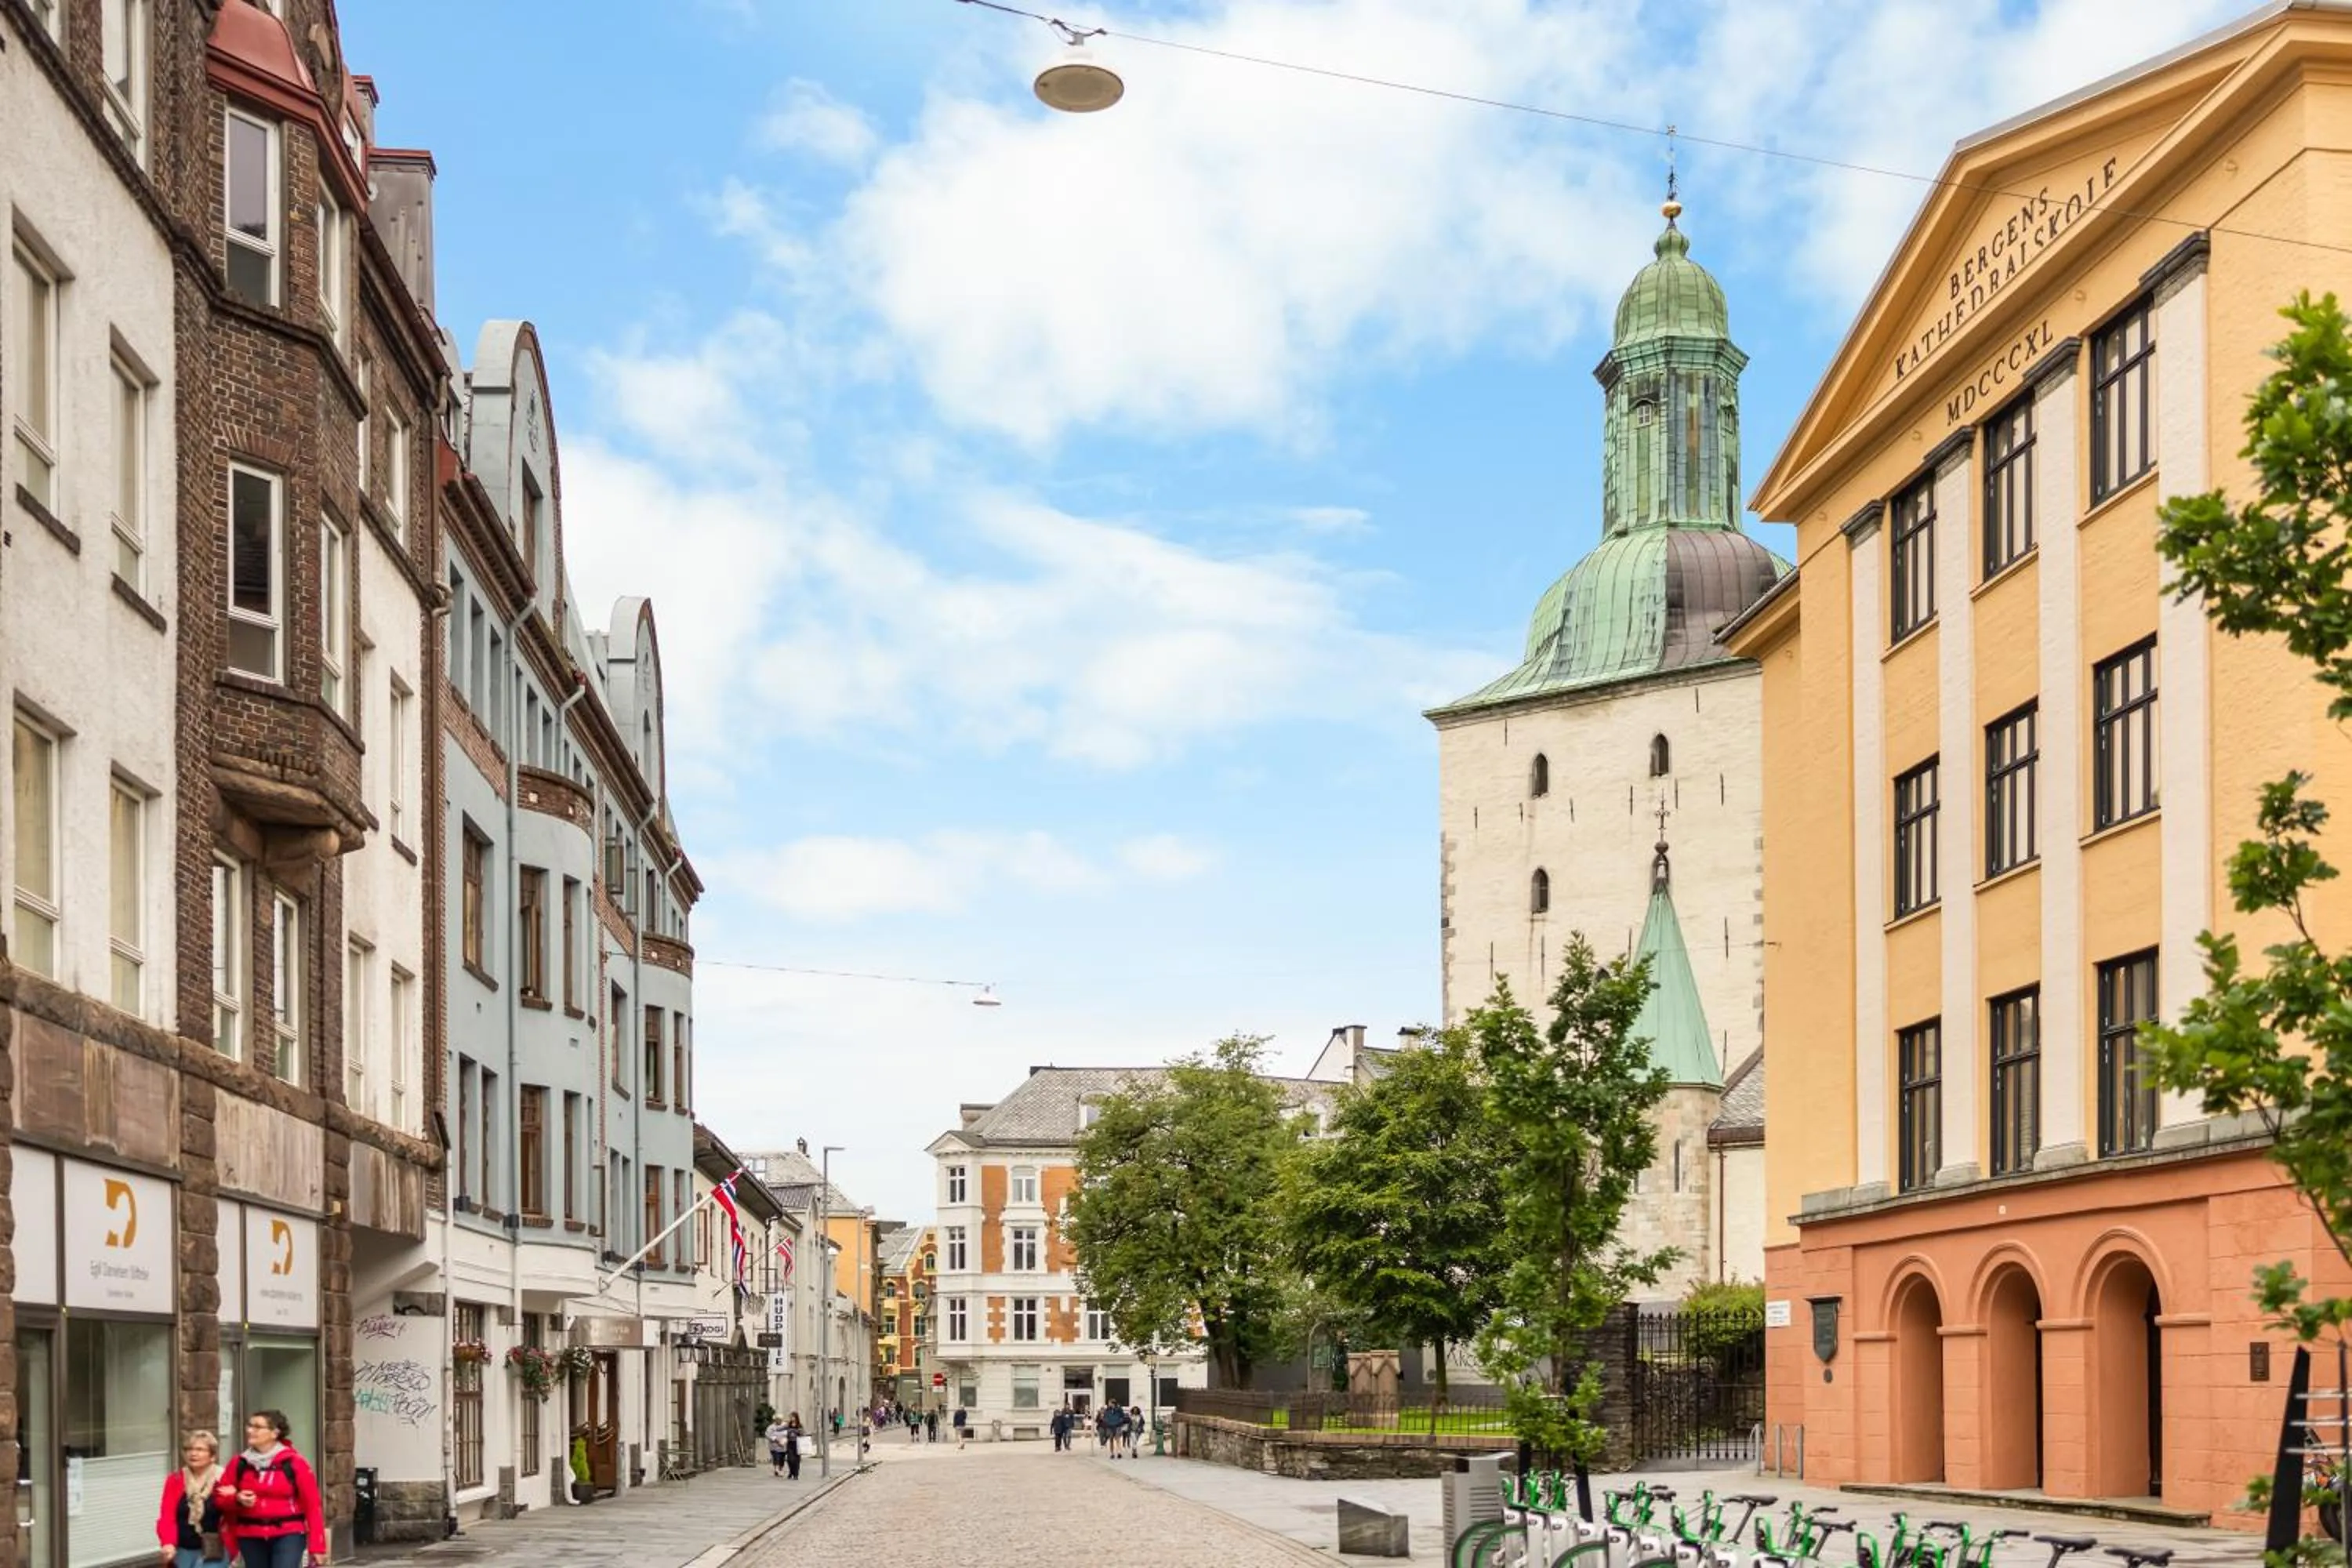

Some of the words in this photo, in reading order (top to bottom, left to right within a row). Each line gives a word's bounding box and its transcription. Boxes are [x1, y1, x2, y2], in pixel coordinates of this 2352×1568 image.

[1950, 187, 2049, 301] BERGENS
[1947, 319, 2055, 427] MDCCCXL
[774, 1298, 783, 1366] HUDPIE
